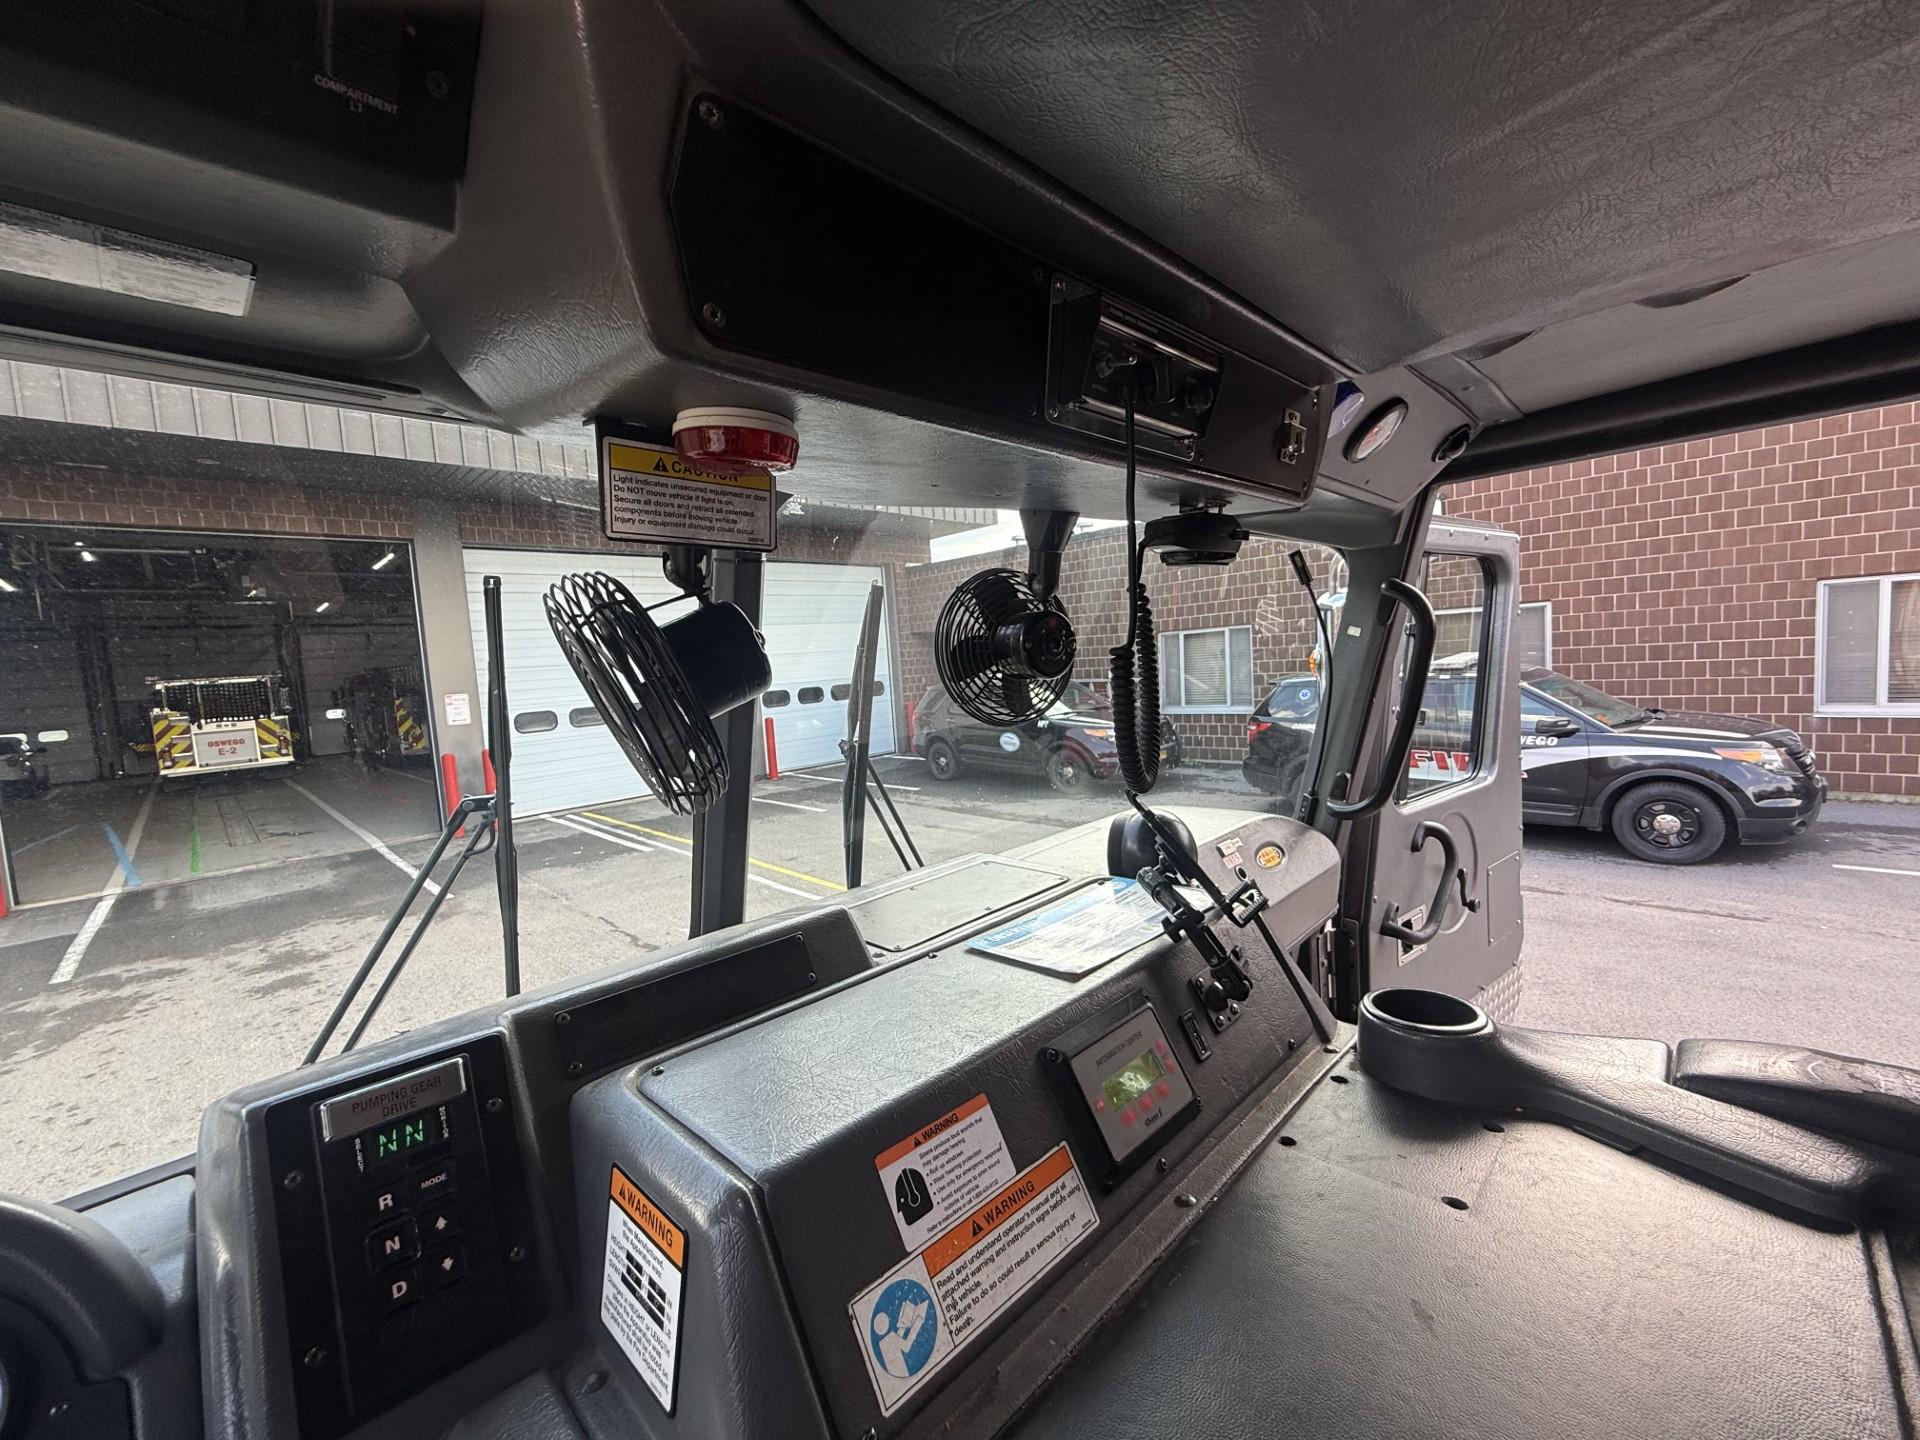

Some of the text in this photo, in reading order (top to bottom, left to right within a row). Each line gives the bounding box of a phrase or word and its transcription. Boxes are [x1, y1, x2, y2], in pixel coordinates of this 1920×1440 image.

[314, 73, 398, 114] COMPARTMENT
[613, 473, 633, 484] Light
[635, 479, 669, 489] indicates
[670, 483, 708, 494] unsecured
[708, 488, 744, 499] equipment
[613, 484, 625, 493] Do
[627, 486, 644, 495] NOT
[646, 490, 667, 498] move
[668, 492, 694, 501] vehicle
[701, 496, 716, 505] light
[613, 494, 642, 505] Secure
[653, 500, 675, 508] doors
[676, 501, 690, 510] and
[691, 504, 714, 513] retract
[725, 508, 755, 518] extended
[614, 506, 662, 517] components
[663, 510, 687, 519] before
[688, 513, 714, 523] moving
[614, 514, 636, 525] Injury
[647, 518, 687, 528] equipment
[687, 522, 715, 532] damage
[716, 525, 735, 534] could
[218, 746, 238, 756] E-2
[352, 1076, 442, 1113] PUMPING GEAR
[382, 1096, 417, 1118] DRIVE
[921, 1112, 959, 1141] WARNING
[933, 1137, 951, 1151] produce
[960, 1122, 975, 1134] sounds
[932, 1147, 949, 1161] damage
[949, 1137, 966, 1149] hearing
[946, 1150, 964, 1164] windows
[945, 1162, 962, 1175] hearing
[962, 1149, 982, 1166] protection
[962, 1160, 985, 1177] emergency
[420, 1172, 448, 1189] MODE
[953, 1179, 973, 1194] exposure
[378, 1193, 393, 1211] R
[944, 1198, 960, 1212] outside
[983, 1180, 1036, 1225] WARNING
[626, 1188, 674, 1249] WARNING
[385, 1235, 401, 1254] N
[936, 1180, 1067, 1290] Read and understand operator's manual and all
[941, 1183, 1082, 1302] attached warning and instruction signs before using
[949, 1302, 972, 1325] Failure
[971, 1296, 980, 1306] to
[979, 1287, 989, 1300] do
[988, 1281, 998, 1292] so
[997, 1265, 1014, 1283] could
[1013, 1251, 1031, 1270] result
[1030, 1246, 1037, 1256] in
[1035, 1229, 1056, 1250] serious
[1055, 1218, 1070, 1234] injury
[1069, 1211, 1076, 1221] or
[391, 1280, 408, 1299] D
[945, 1280, 982, 1313] this vehicle.
[954, 1315, 975, 1338] death.
[650, 1327, 671, 1359] LENGTH
